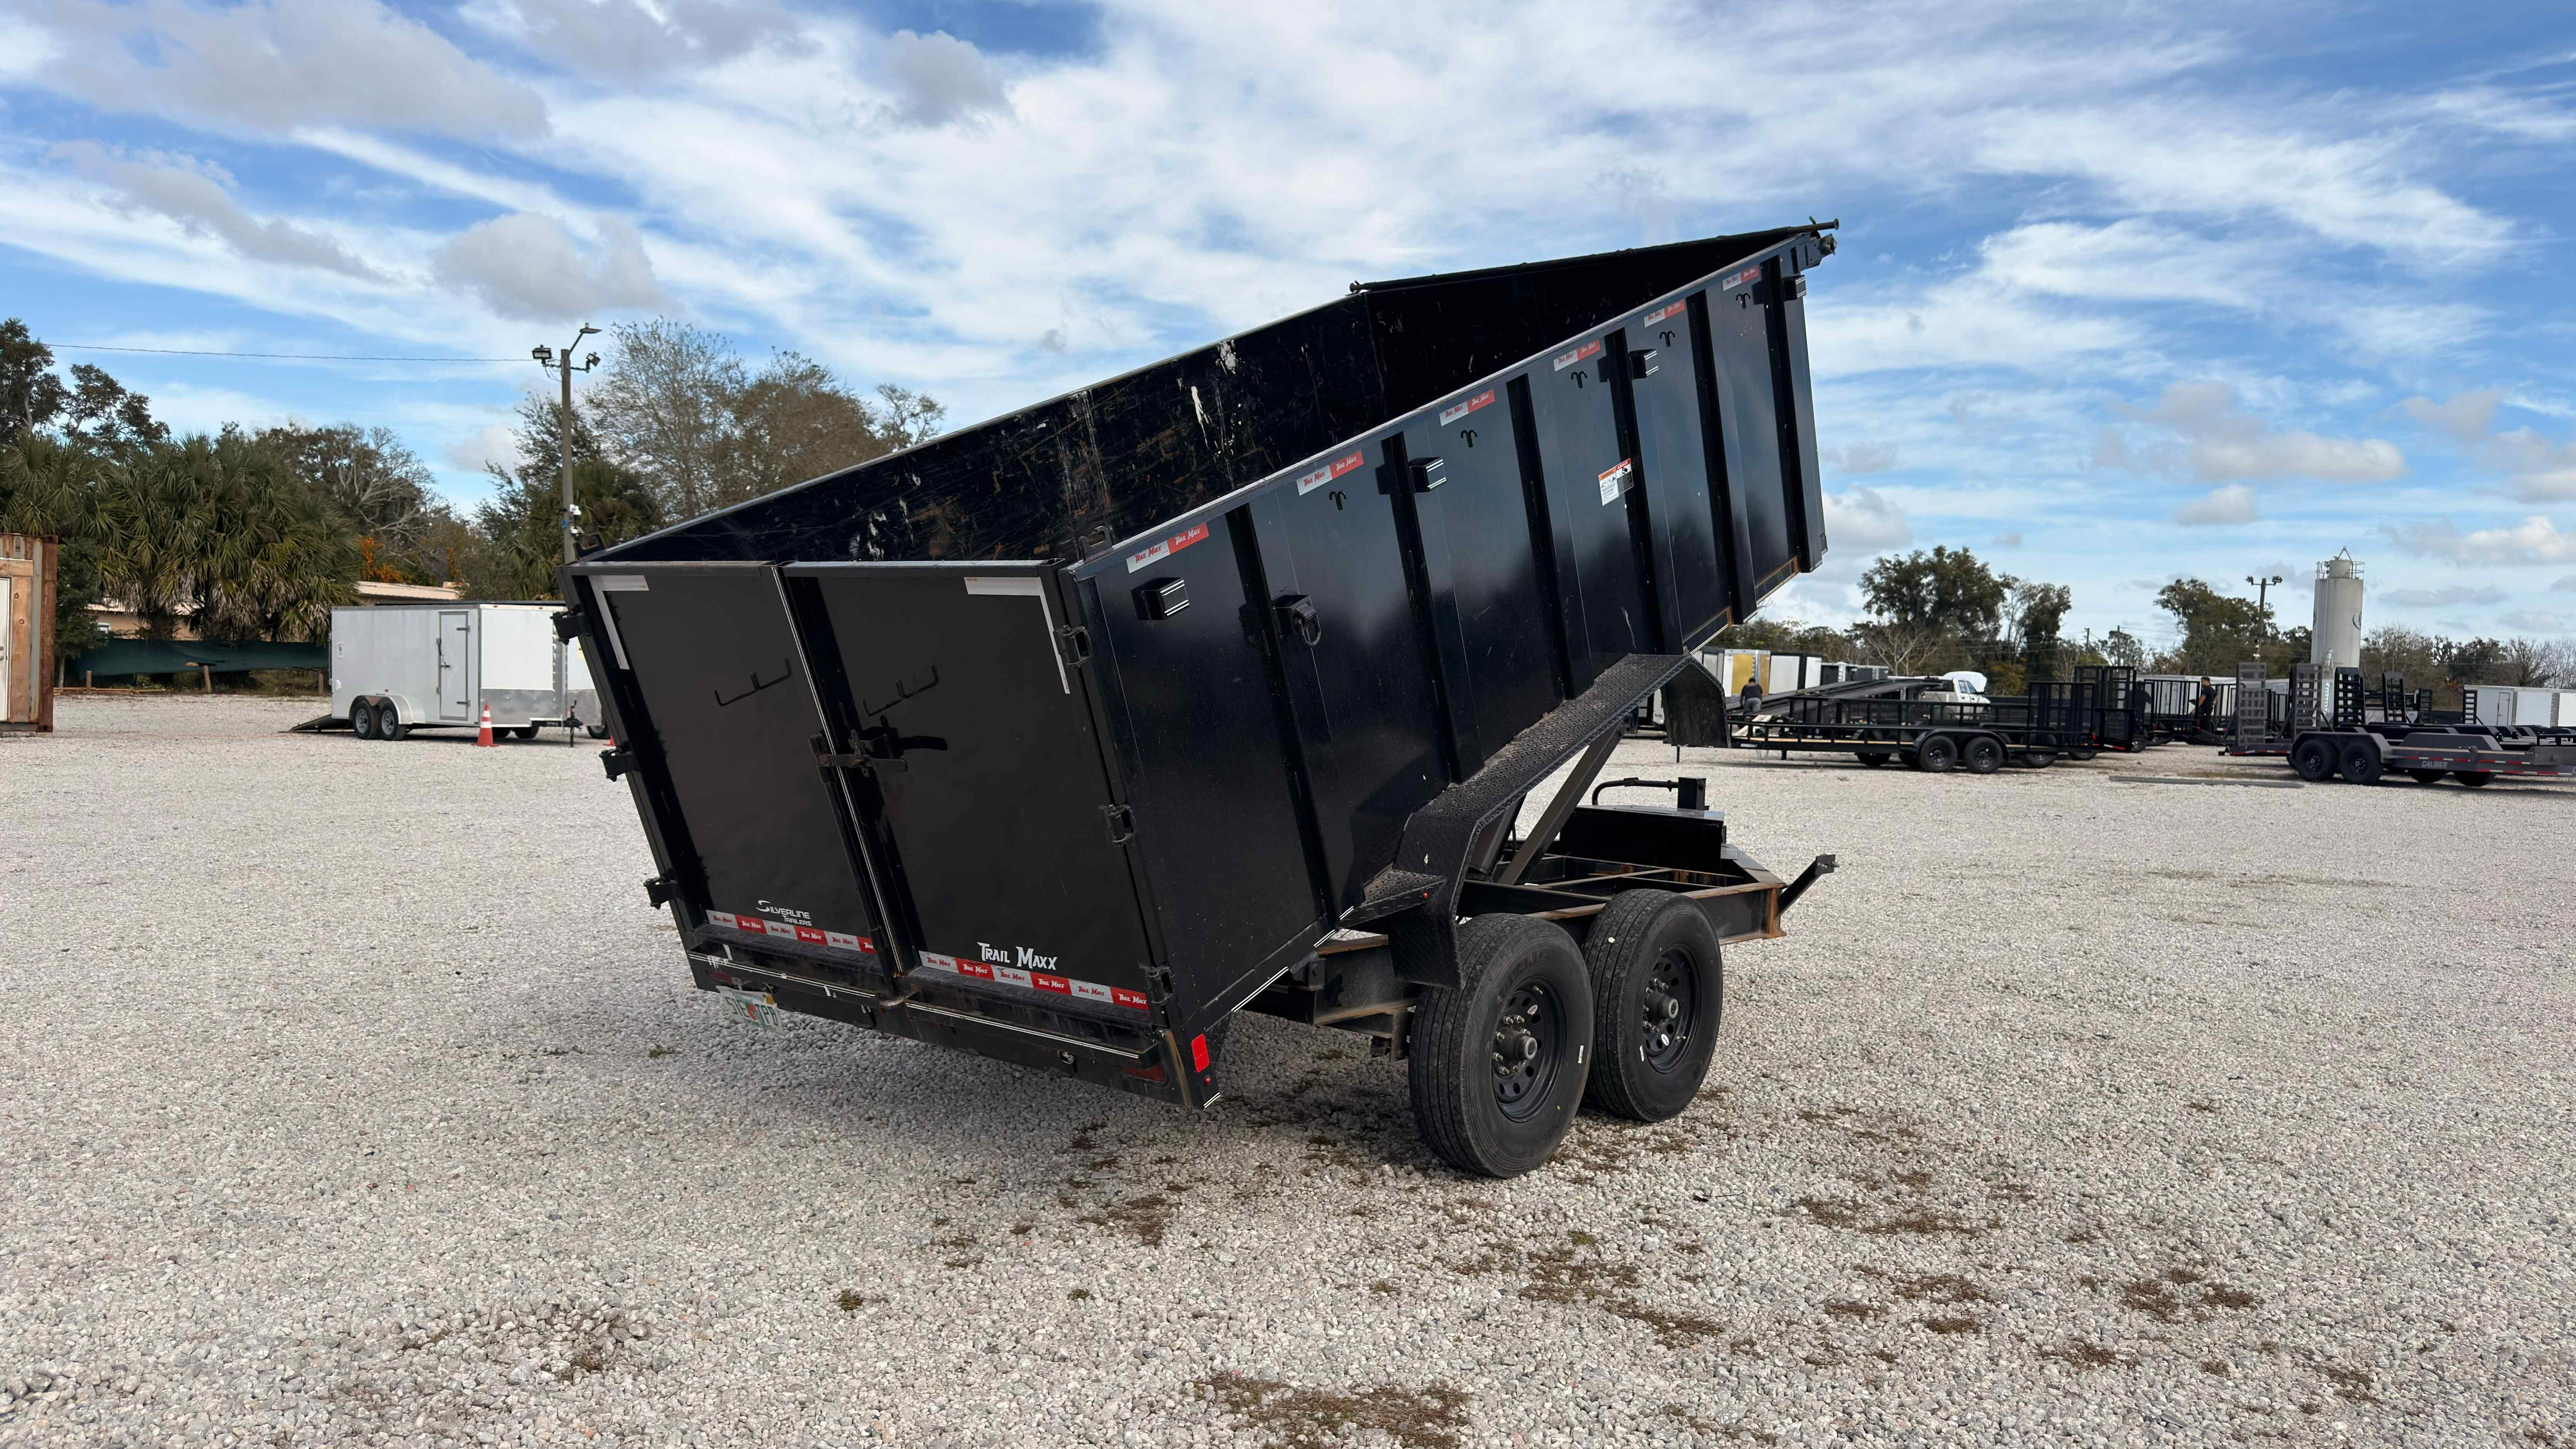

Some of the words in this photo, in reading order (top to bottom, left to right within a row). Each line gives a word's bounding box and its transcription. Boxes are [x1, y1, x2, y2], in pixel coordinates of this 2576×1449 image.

[1175, 535, 1186, 545] TRAIL
[1188, 528, 1201, 540] MAXX
[1134, 553, 1147, 563] TRAIL
[1148, 545, 1161, 557] MAXX
[782, 915, 812, 926] TRAILERS
[977, 942, 1010, 963] TRAIL
[1015, 946, 1058, 971] MAXX
[975, 966, 988, 974] MAXX
[1038, 978, 1050, 986] TRAIL
[1051, 980, 1065, 988] MAXX
[1091, 988, 1105, 996] MAXX
[1118, 993, 1131, 1002] TRAIL
[1132, 996, 1147, 1005] MAXX
